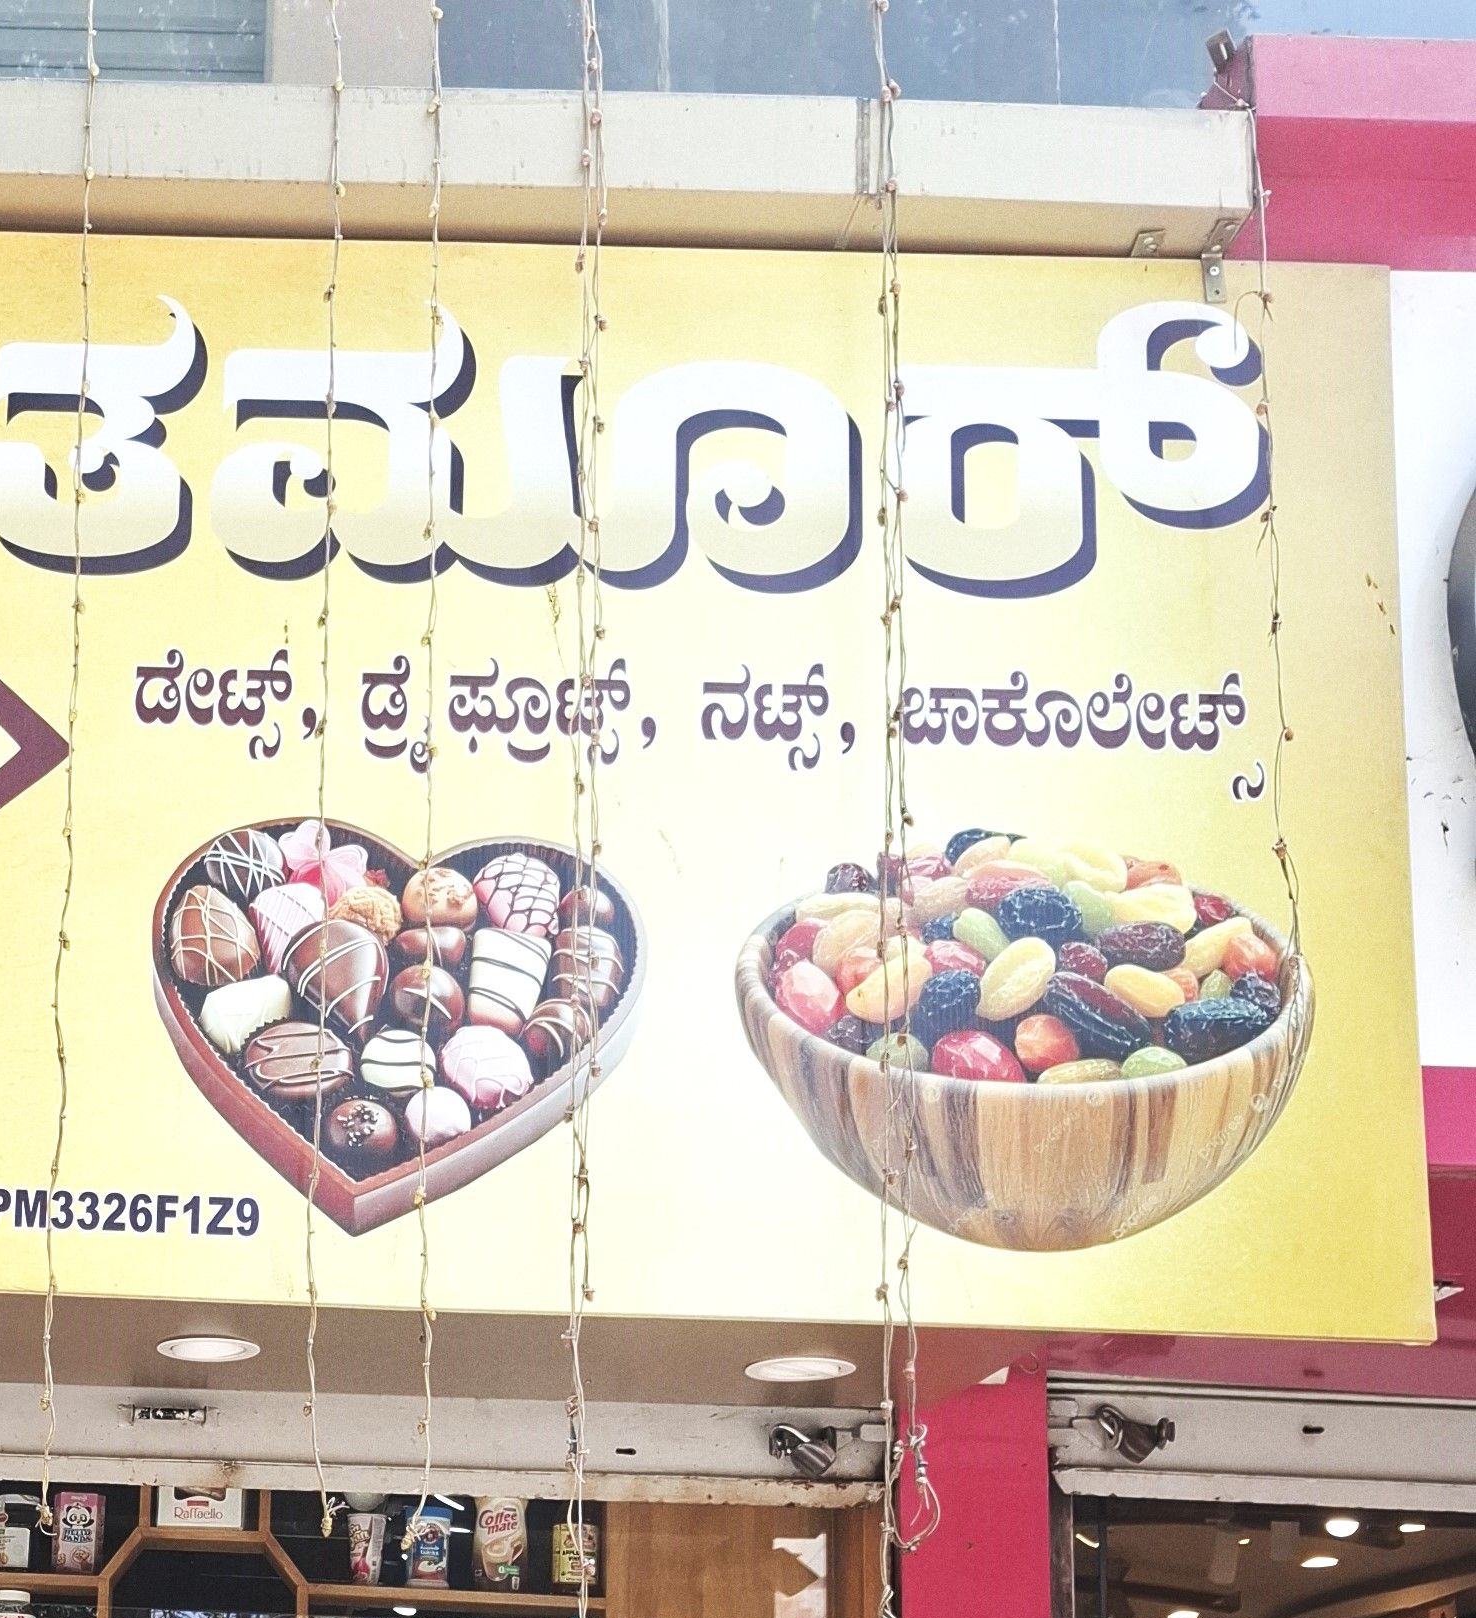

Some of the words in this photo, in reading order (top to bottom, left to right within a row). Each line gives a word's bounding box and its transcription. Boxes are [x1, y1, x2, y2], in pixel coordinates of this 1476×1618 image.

[135, 648, 317, 760] ಡೇಟ್ಸ್,
[701, 662, 856, 771] ನಟ್ಸ್,
[174, 1506, 223, 1521] Raffaello
[479, 1509, 517, 1528] Coffee
[487, 1521, 517, 1535] mate
